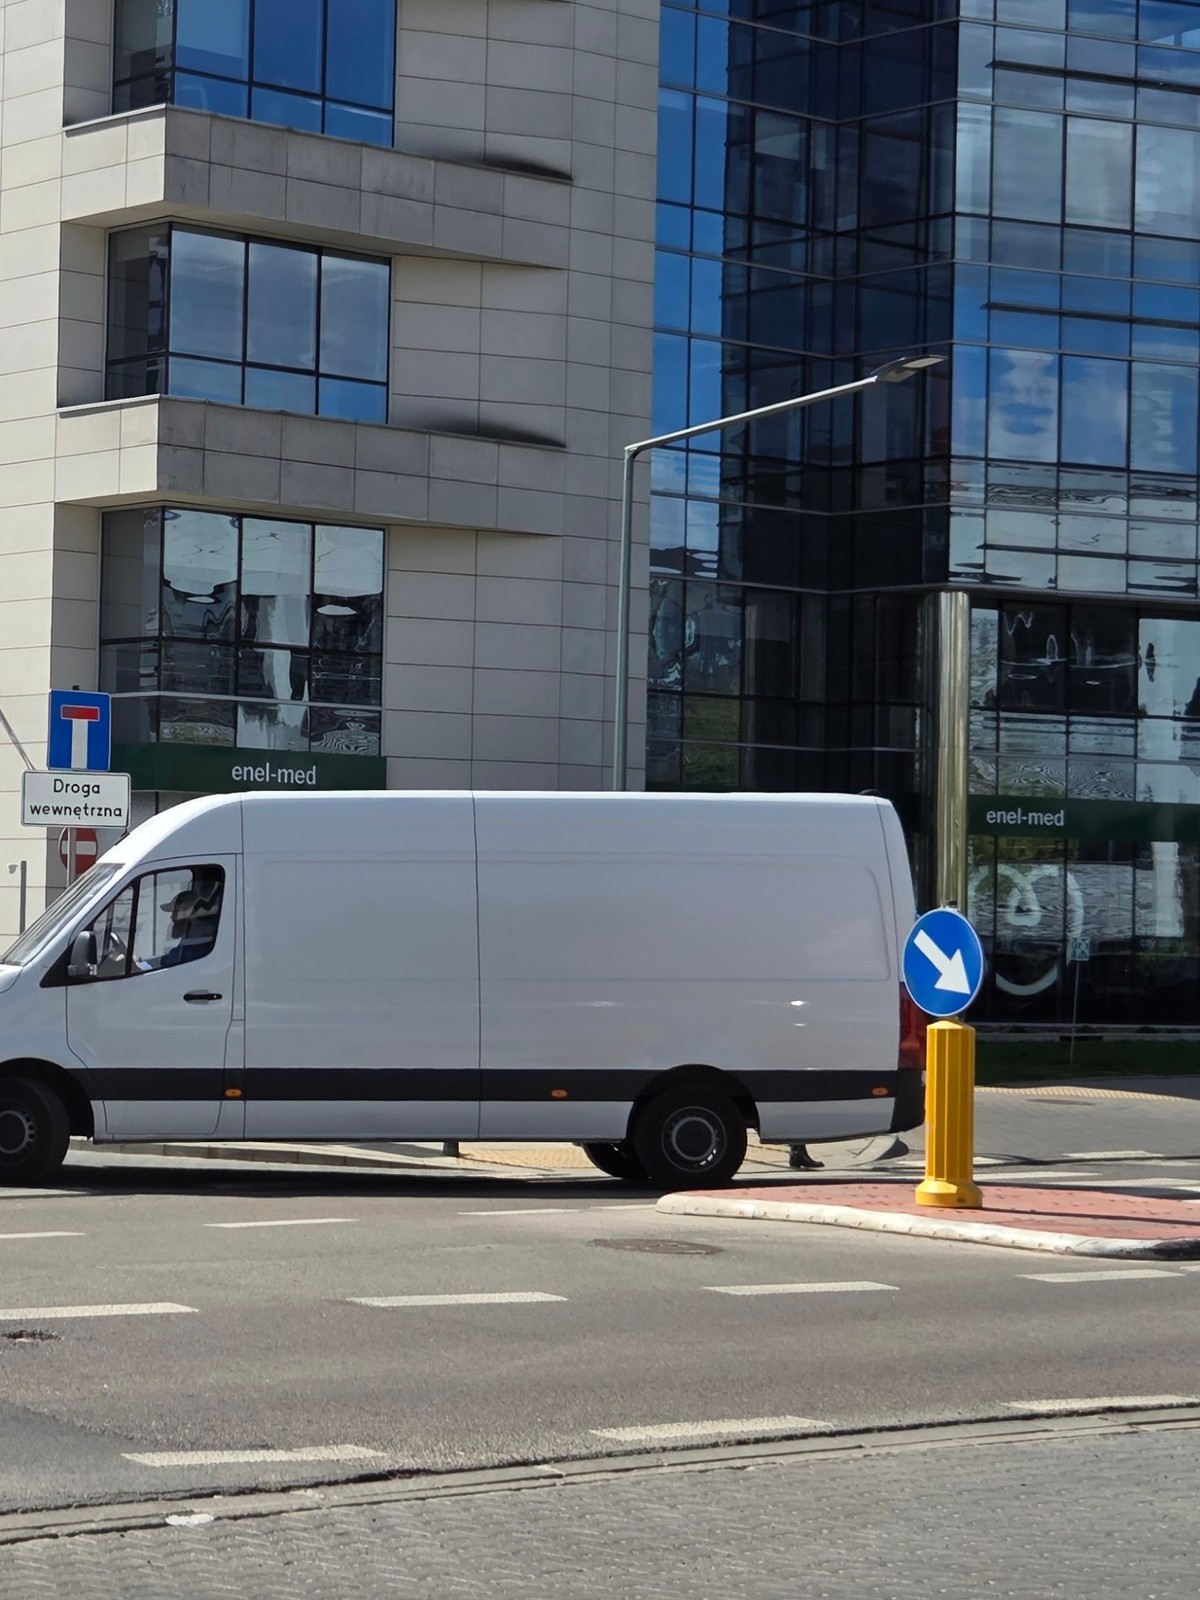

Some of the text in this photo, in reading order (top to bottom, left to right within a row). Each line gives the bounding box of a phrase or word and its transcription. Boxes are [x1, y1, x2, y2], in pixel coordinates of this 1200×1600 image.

[231, 762, 317, 785] enel-med
[53, 778, 101, 798] Droga
[29, 803, 123, 821] wewnętrzna
[985, 807, 1065, 827] enel-med
